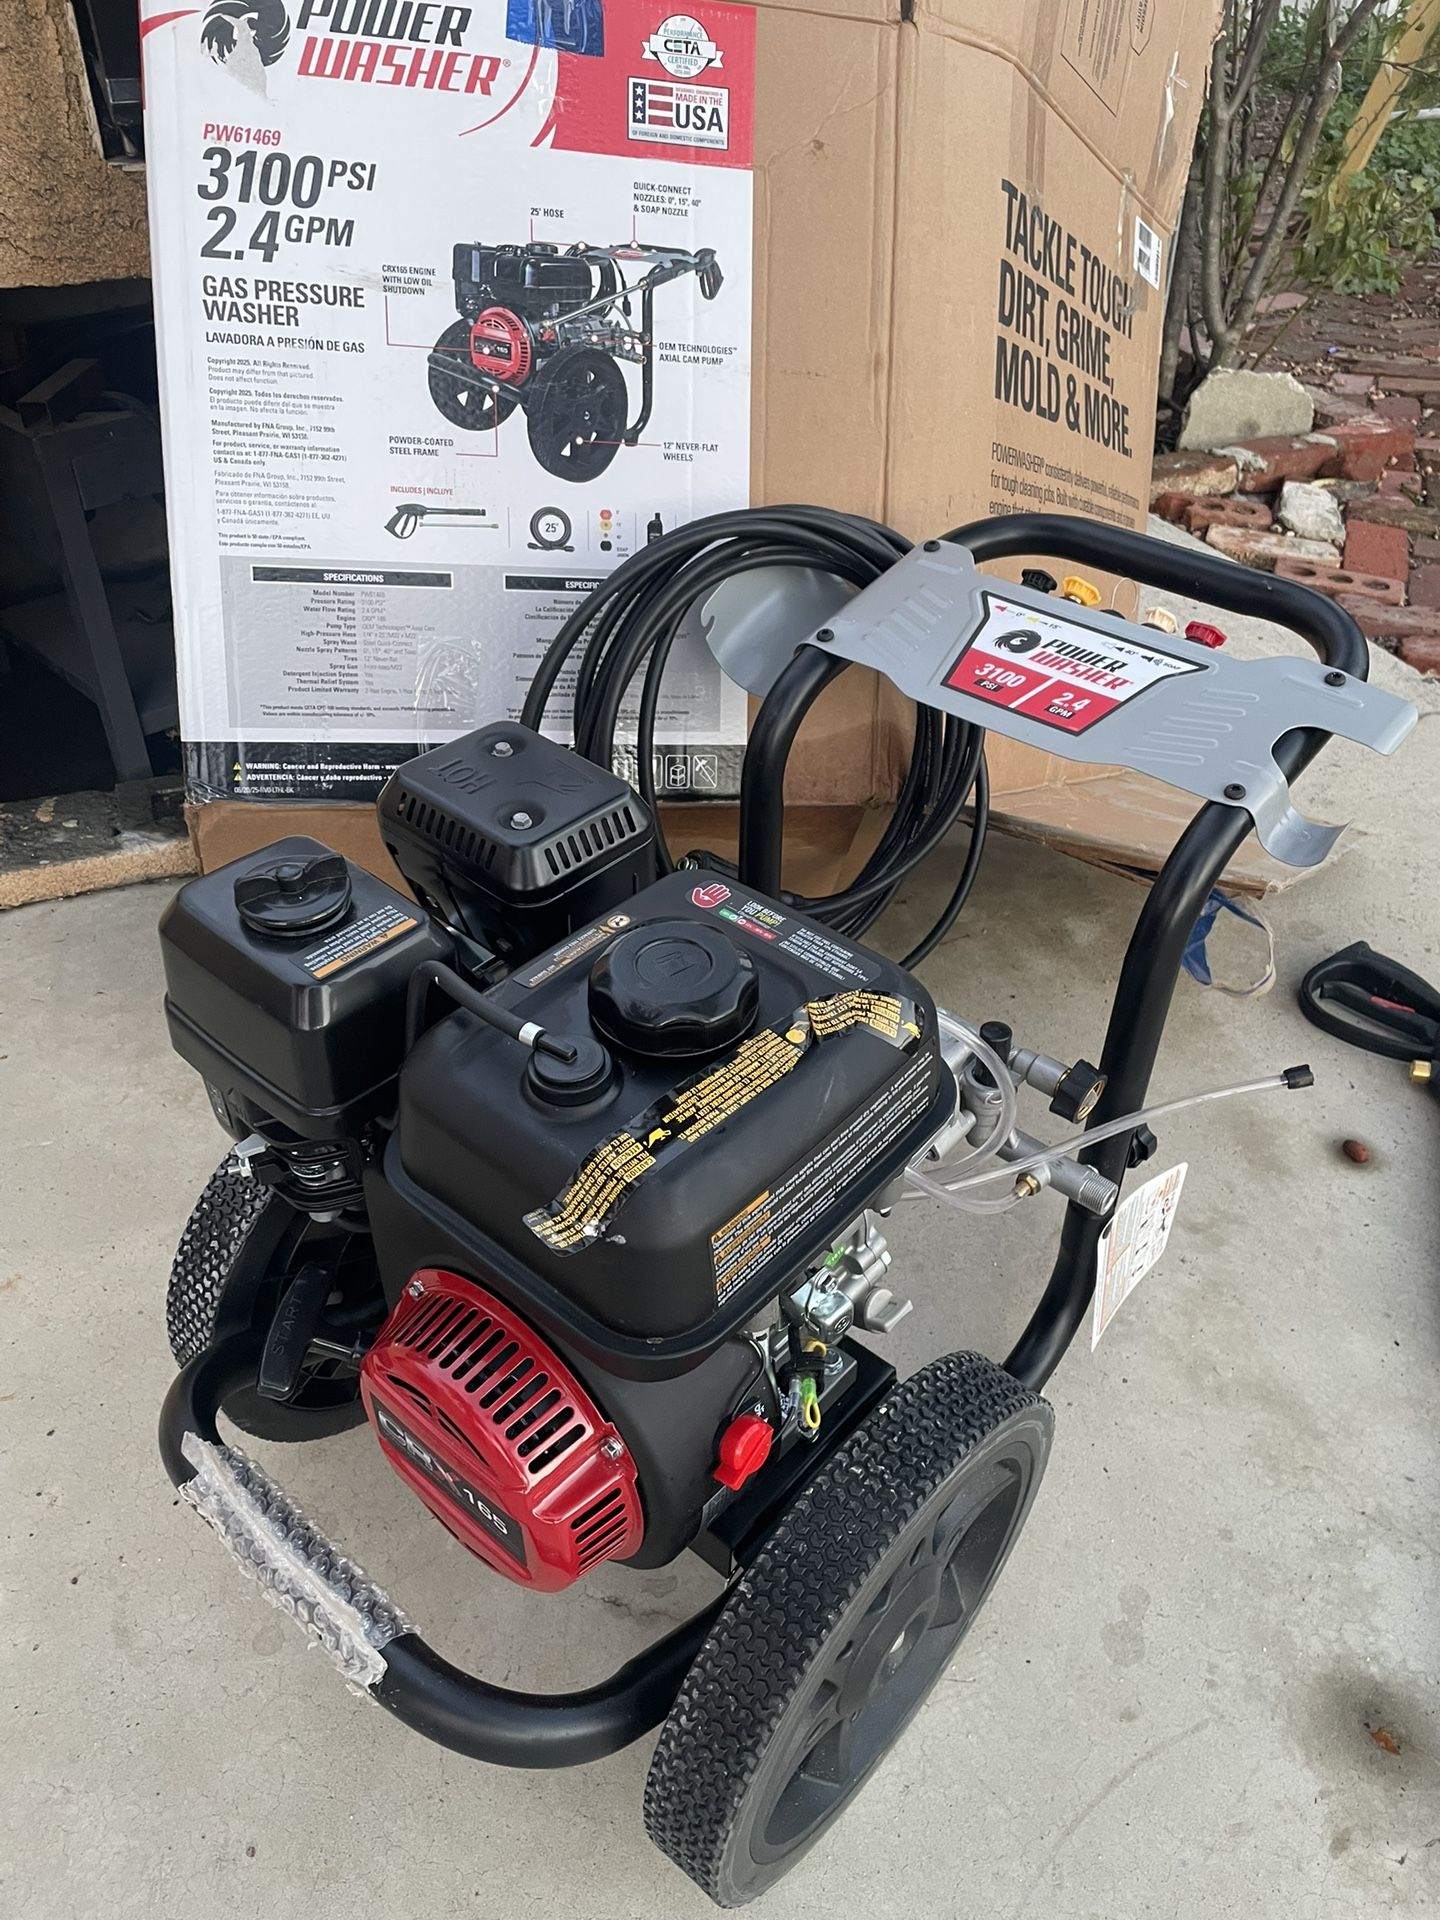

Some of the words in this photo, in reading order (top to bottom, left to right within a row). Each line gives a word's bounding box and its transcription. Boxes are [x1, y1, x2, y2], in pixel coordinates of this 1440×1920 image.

[296, 0, 472, 46] POWER
[664, 39, 700, 55] CETA
[668, 56, 698, 66] CERTIFIED
[675, 93, 698, 103] MADE
[699, 96, 707, 104] IN
[709, 97, 723, 106] THE
[675, 103, 723, 132] USA
[203, 123, 281, 146] PW61469
[197, 146, 324, 209] 3100
[327, 160, 376, 191] PSI
[633, 182, 691, 195] QUICK-CONNECT
[543, 208, 564, 219] HOSE
[633, 204, 639, 212] &
[641, 205, 660, 214] SOAP
[662, 207, 688, 217] NOZZLE
[200, 205, 281, 263] 2.4
[284, 214, 355, 247] GPM
[1001, 178, 1077, 298] TACKLE
[1080, 244, 1134, 340] TOUGH
[382, 264, 409, 275] CRX165
[410, 266, 437, 276] ENGINE
[202, 275, 248, 299] GAS
[254, 279, 365, 308] PRESSURE
[382, 276, 402, 285] WITH
[403, 276, 419, 286] LOW
[420, 277, 433, 287] OIL
[382, 284, 425, 296] SHUTDOWN
[202, 299, 300, 327] WASHER
[999, 258, 1051, 357] DIRT,
[1055, 299, 1116, 395] GRIME,
[206, 332, 264, 347] LAVADORA
[267, 336, 275, 347] A
[277, 336, 324, 351] PRESIÓN
[326, 340, 341, 352] DE
[342, 341, 365, 353] GAS
[658, 341, 677, 352] OEM
[659, 353, 682, 363] AXIAL
[683, 355, 700, 364] CAM
[701, 356, 724, 365] PUMP
[994, 335, 1061, 424] MOLD
[1065, 373, 1081, 435] &
[1084, 382, 1133, 458] MORE.
[211, 419, 252, 429] Manufactured
[254, 422, 261, 430] by
[388, 435, 454, 447] POWDER-COATED
[676, 442, 719, 453] NEVER-FLAT
[389, 446, 411, 457] STEEL
[413, 447, 440, 457] FRAME
[663, 451, 694, 463] WHEELS
[390, 485, 422, 495] INCLUDES
[427, 487, 453, 495] INCLUYE
[1001, 474, 1018, 496] tough
[323, 573, 384, 583] SPECIFICATIONS
[313, 589, 331, 597] Model
[1041, 638, 1128, 673] POWER
[974, 663, 1027, 688] 3100
[980, 680, 997, 691] PSI
[1051, 692, 1092, 712] 2.4
[1048, 706, 1073, 719] GPM
[320, 763, 362, 772] Reproductive
[428, 759, 496, 795] HOT
[741, 904, 758, 916] YOU
[754, 912, 781, 928] PUMP!
[746, 901, 764, 911] LOOK
[761, 908, 787, 923] BEFORE
[340, 939, 383, 963] WARNING
[612, 1145, 641, 1169] ATENCION
[613, 1169, 626, 1181] OIL
[624, 1157, 654, 1182] CAUTION
[593, 1178, 618, 1208] PROVIDED
[606, 1180, 627, 1205] ENGINE
[574, 1222, 584, 1232] TO
[270, 1294, 302, 1355] START
[378, 1411, 463, 1498] CRX
[463, 1488, 508, 1535] 165
